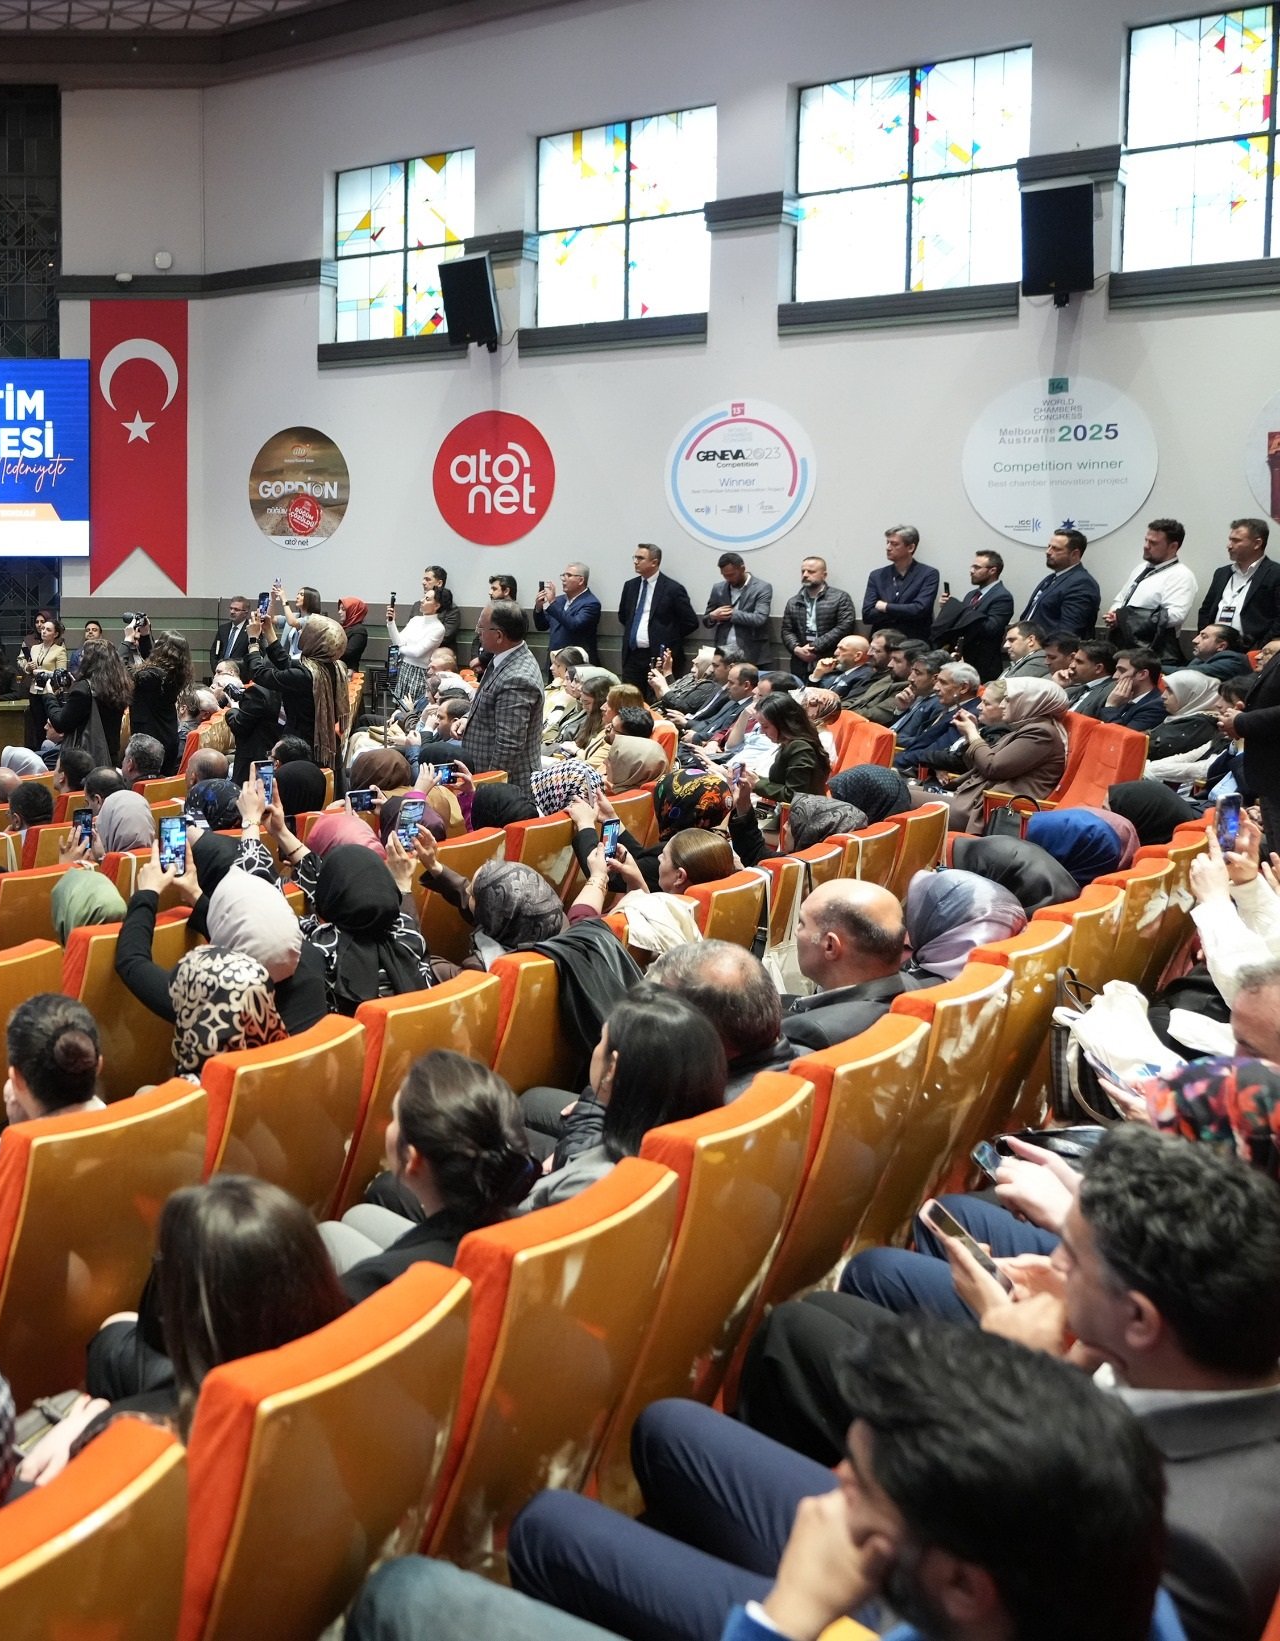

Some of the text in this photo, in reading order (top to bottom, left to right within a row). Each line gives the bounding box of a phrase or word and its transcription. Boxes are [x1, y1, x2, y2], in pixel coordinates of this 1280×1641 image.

[1042, 398, 1075, 406] WORLD
[1033, 405, 1083, 414] CHAMBERS
[1033, 412, 1083, 421] CONGRESS
[999, 423, 1119, 442] Melbourne 2025
[998, 435, 1056, 445] Australia
[450, 448, 520, 485] ato
[993, 459, 1123, 474] Competition winner
[719, 478, 756, 487] Winner
[988, 477, 1128, 488] Best chamber innovation project
[467, 473, 536, 514] net
